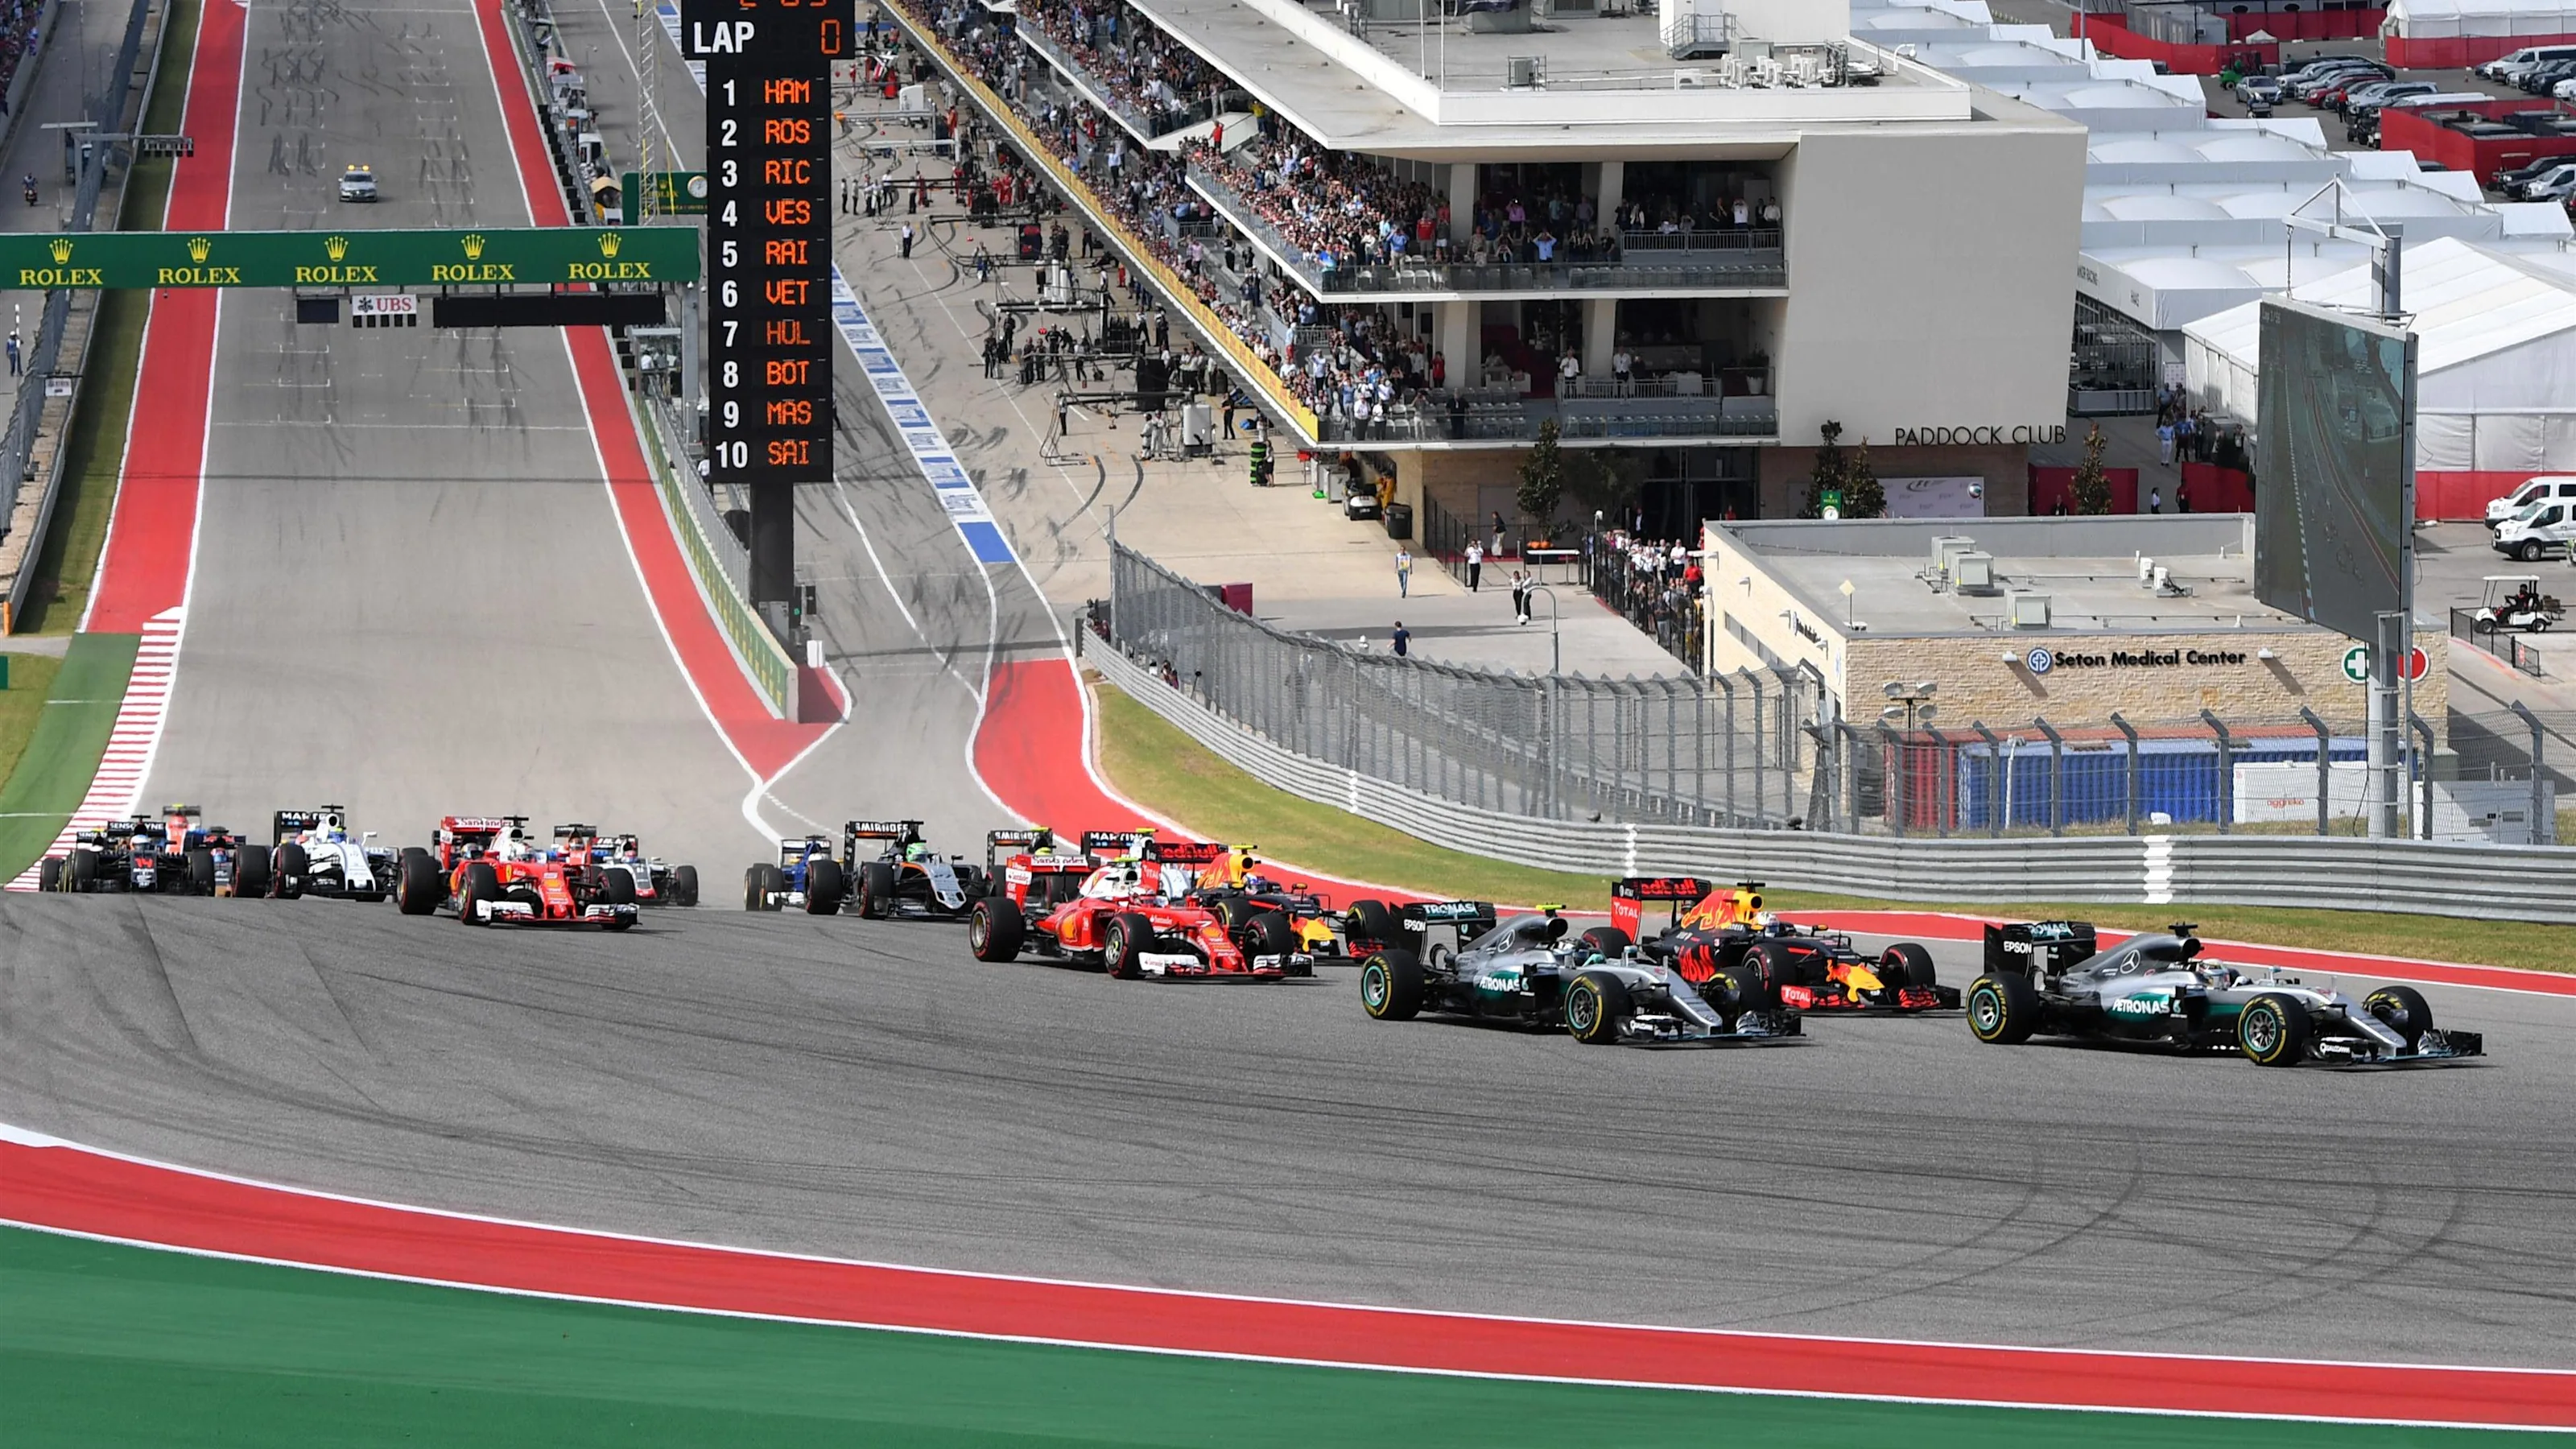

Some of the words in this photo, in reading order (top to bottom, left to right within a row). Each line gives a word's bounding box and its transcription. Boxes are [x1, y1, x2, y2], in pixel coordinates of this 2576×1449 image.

[694, 21, 755, 54] LAP
[820, 19, 840, 55] 0
[723, 79, 736, 106] 1
[765, 79, 811, 104] HAM
[721, 119, 737, 147] 2
[766, 119, 810, 144] ROS
[721, 159, 737, 188] 3
[766, 159, 811, 184] RIC
[721, 200, 738, 227] 4
[766, 199, 811, 225] VES
[722, 240, 738, 267] 5
[766, 240, 808, 265] RAI
[19, 268, 103, 286] ROLEX
[159, 267, 241, 284] ROLEX
[295, 266, 378, 283] ROLEX
[432, 264, 515, 280] ROLEX
[568, 262, 651, 279] ROLEX
[722, 280, 738, 308] 6
[766, 280, 809, 305] VET
[376, 298, 412, 312] UBS
[722, 320, 739, 347] 7
[766, 320, 811, 345] HUL
[723, 361, 739, 388] 8
[766, 361, 809, 385] BOT
[723, 401, 739, 428] 9
[767, 400, 811, 425] MAS
[1894, 425, 2004, 446] PADDOCK
[2012, 424, 2066, 444] CLUB
[715, 440, 749, 469] 10
[767, 440, 810, 465] SAI
[2054, 651, 2106, 667] Seton
[2111, 650, 2179, 667] Medical
[2186, 649, 2247, 665] Center
[1612, 901, 1638, 919] TOTAL
[1195, 920, 1212, 928] 7
[1403, 919, 1426, 932] EPSON
[2003, 940, 2033, 955] EPSON
[1479, 976, 1521, 992] PETRONAS
[1785, 989, 1811, 1002] TOTAL
[2112, 998, 2170, 1014] PETRONAS
